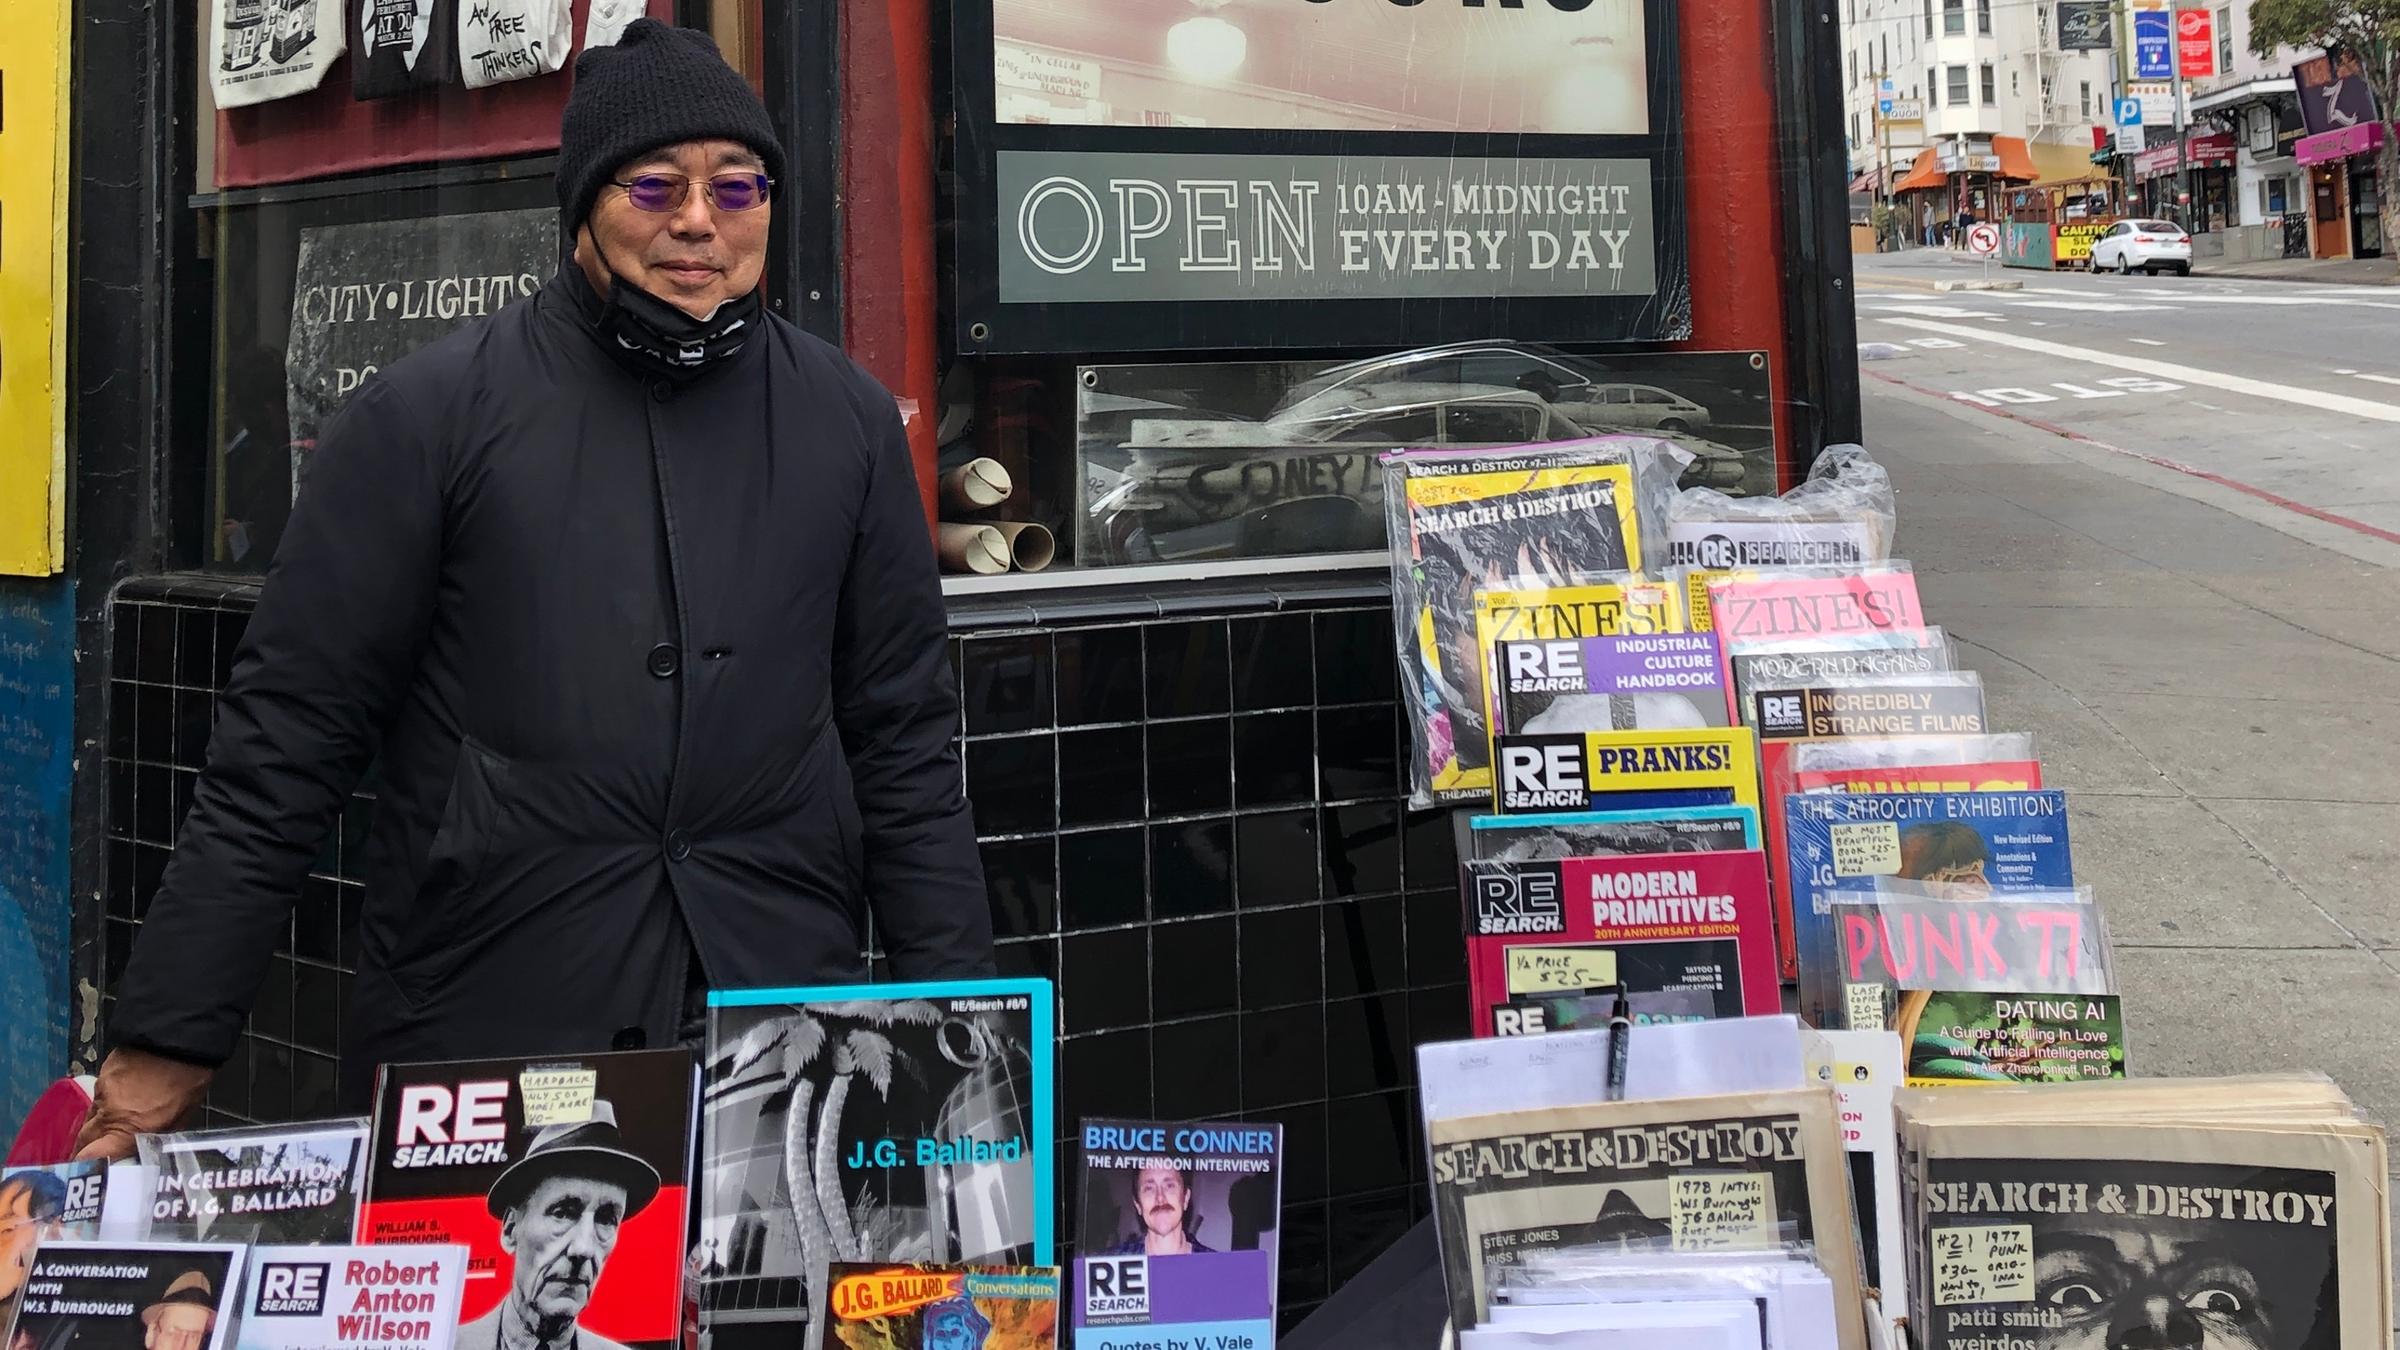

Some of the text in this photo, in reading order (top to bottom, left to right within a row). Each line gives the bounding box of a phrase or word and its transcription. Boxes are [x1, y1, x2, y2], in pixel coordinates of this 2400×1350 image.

[488, 12, 525, 43] FREE
[471, 41, 542, 78] THINKERS
[1969, 158, 1998, 169] Liquor
[1017, 175, 1320, 275] OPEN
[1338, 184, 1424, 216] 10AM
[1451, 182, 1630, 216] MIDNIGHT
[2060, 225, 2111, 236] CAUTIO
[1339, 230, 1632, 274] EVERY DAY
[2073, 236, 2096, 246] SLO
[1410, 463, 1457, 478] SEARCH
[1472, 460, 1527, 473] DESTROY
[1414, 505, 1500, 535] SEARCH
[1517, 487, 1616, 519] DESTROY
[1491, 600, 1668, 641] ZINES!
[1727, 588, 1909, 637] ZINES!
[1615, 637, 1712, 654] INDUSTRIAL
[1507, 641, 1583, 679] RE
[1644, 654, 1713, 671] CULTURE
[1616, 672, 1716, 689] HANDBOOK
[1762, 695, 1803, 719] RE
[1812, 693, 1932, 713] INCREDIBLY
[1814, 714, 1981, 735] STRANGE FILMS
[1501, 744, 1584, 793] RE
[1599, 744, 1731, 775] PRANKS!
[1799, 796, 2054, 820] THE ATROCITY EXHIBITION
[1476, 871, 1559, 919] RE
[1591, 869, 1698, 899] MODERN
[1593, 895, 1737, 927] PRIMITIVES
[1594, 924, 1741, 940] 20TH ANNIVERSARY EDITION
[1843, 910, 2008, 981] PUNK
[1535, 955, 1572, 969] PRICE
[1495, 1007, 1548, 1036] RE
[1995, 1000, 2105, 1020] DATING AI
[1939, 1026, 2108, 1043] A Guide to Falling In Love
[1949, 1046, 2110, 1062] with Artificial Intelligence
[1965, 1062, 1977, 1075] by
[1980, 1062, 2004, 1073] Alex
[395, 1080, 510, 1145] RE
[847, 1135, 1022, 1170] J.G. Ballard
[1084, 1126, 1275, 1154] BRUCE CONNER
[1434, 1118, 1805, 1186] SEARCH & DESTROY
[1086, 1154, 1271, 1173] THE AFTERNOON INTERVIEWS
[157, 1163, 346, 1192] IN CELEBRATION
[1676, 1180, 1712, 1195] 1978
[64, 1174, 102, 1209] RE
[153, 1201, 184, 1219] OF
[231, 1187, 338, 1214] BALLARD
[1927, 1181, 2334, 1228] SEARCH & DESTROY
[375, 1220, 426, 1233] WILLIAM
[1483, 1229, 1560, 1250] STEVE JONES
[1985, 1230, 2020, 1244] 1977
[1485, 1251, 1513, 1266] RUSS
[1989, 1243, 2028, 1258] PUNK
[33, 1263, 43, 1276] A
[264, 1259, 440, 1301] RE Robert
[1087, 1260, 1147, 1298] RE
[351, 1287, 436, 1314] Anton
[839, 1277, 1055, 1316] J.G. BALLARD Conversations
[336, 1314, 432, 1342] Wilson
[1086, 1314, 1151, 1326] researchpubs.com
[1947, 1305, 2063, 1333] patti smith
[1215, 1334, 1254, 1350] Vale
[1947, 1332, 2037, 1350] weirdos
